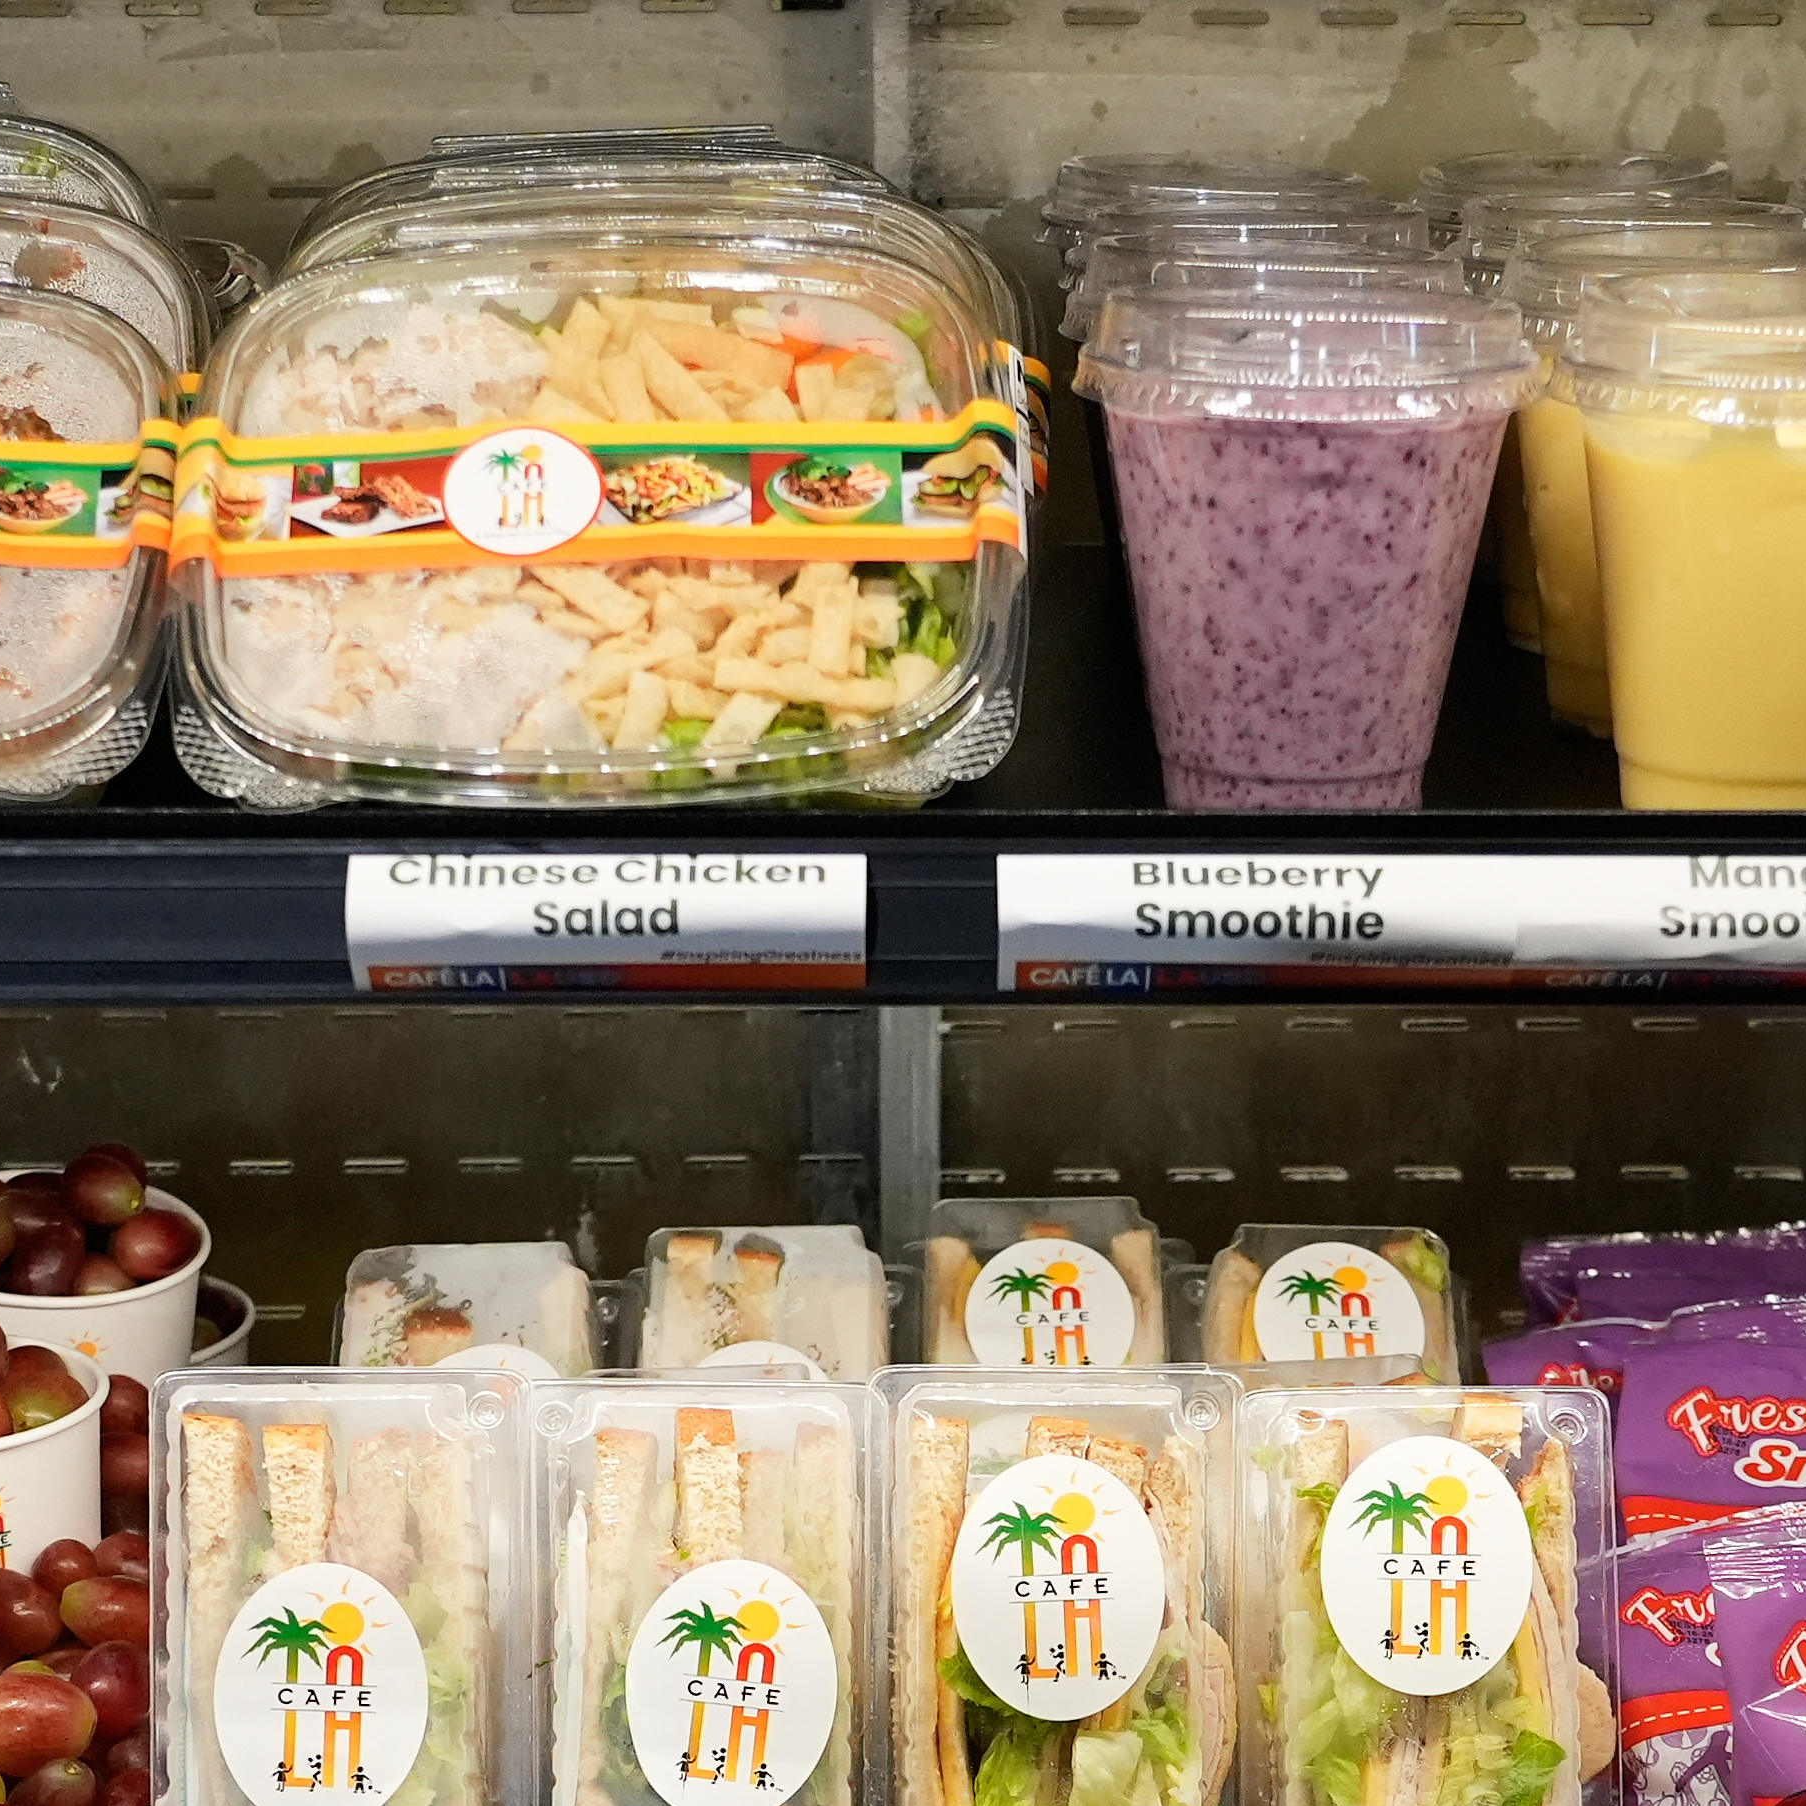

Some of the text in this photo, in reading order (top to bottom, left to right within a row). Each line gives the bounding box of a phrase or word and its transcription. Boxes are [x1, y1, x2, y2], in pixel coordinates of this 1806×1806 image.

[389, 855, 826, 887] Chinese Chicken
[1133, 861, 1384, 898] Blueberry
[533, 901, 679, 937] Salad
[1134, 901, 1385, 942] Smoothie
[1105, 967, 1140, 986] LA
[1015, 1311, 1090, 1326] CAFE
[1304, 1317, 1379, 1331] CAFE
[1383, 1560, 1477, 1577] CAFE
[1014, 1577, 1109, 1598] CAFE
[276, 1686, 374, 1708] CAFE
[686, 1678, 781, 1707] CAFE
